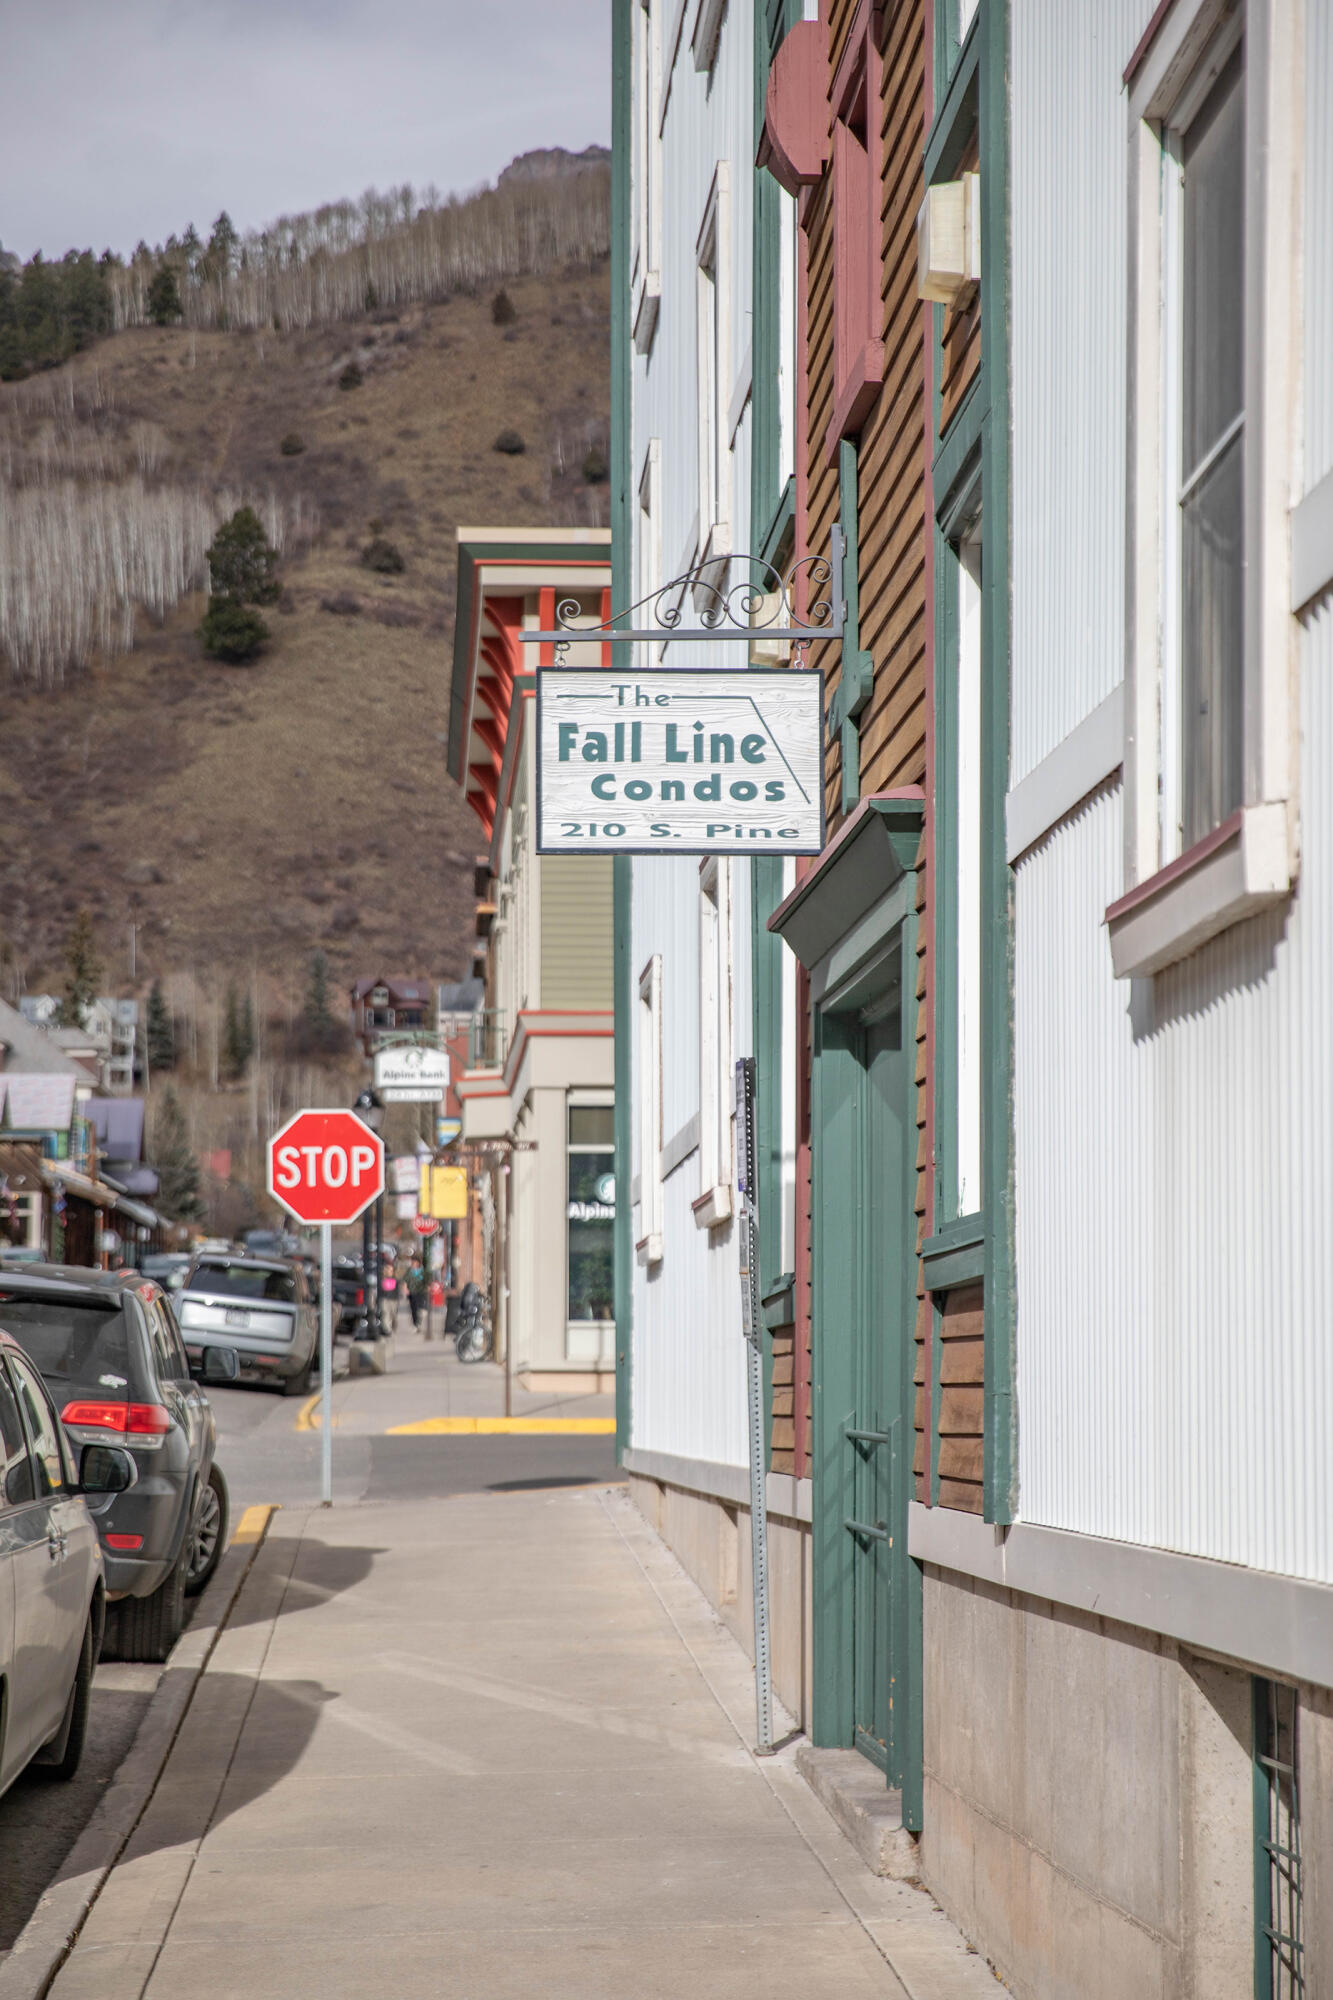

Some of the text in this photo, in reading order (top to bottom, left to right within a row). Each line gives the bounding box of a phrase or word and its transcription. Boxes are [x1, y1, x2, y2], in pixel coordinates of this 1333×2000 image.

[610, 684, 672, 706] The
[558, 720, 767, 764] Fall Line
[590, 773, 786, 802] Condos
[560, 822, 800, 839] 210 S. Pine
[383, 1069, 446, 1080] Alpine Bank
[277, 1144, 376, 1189] STOP
